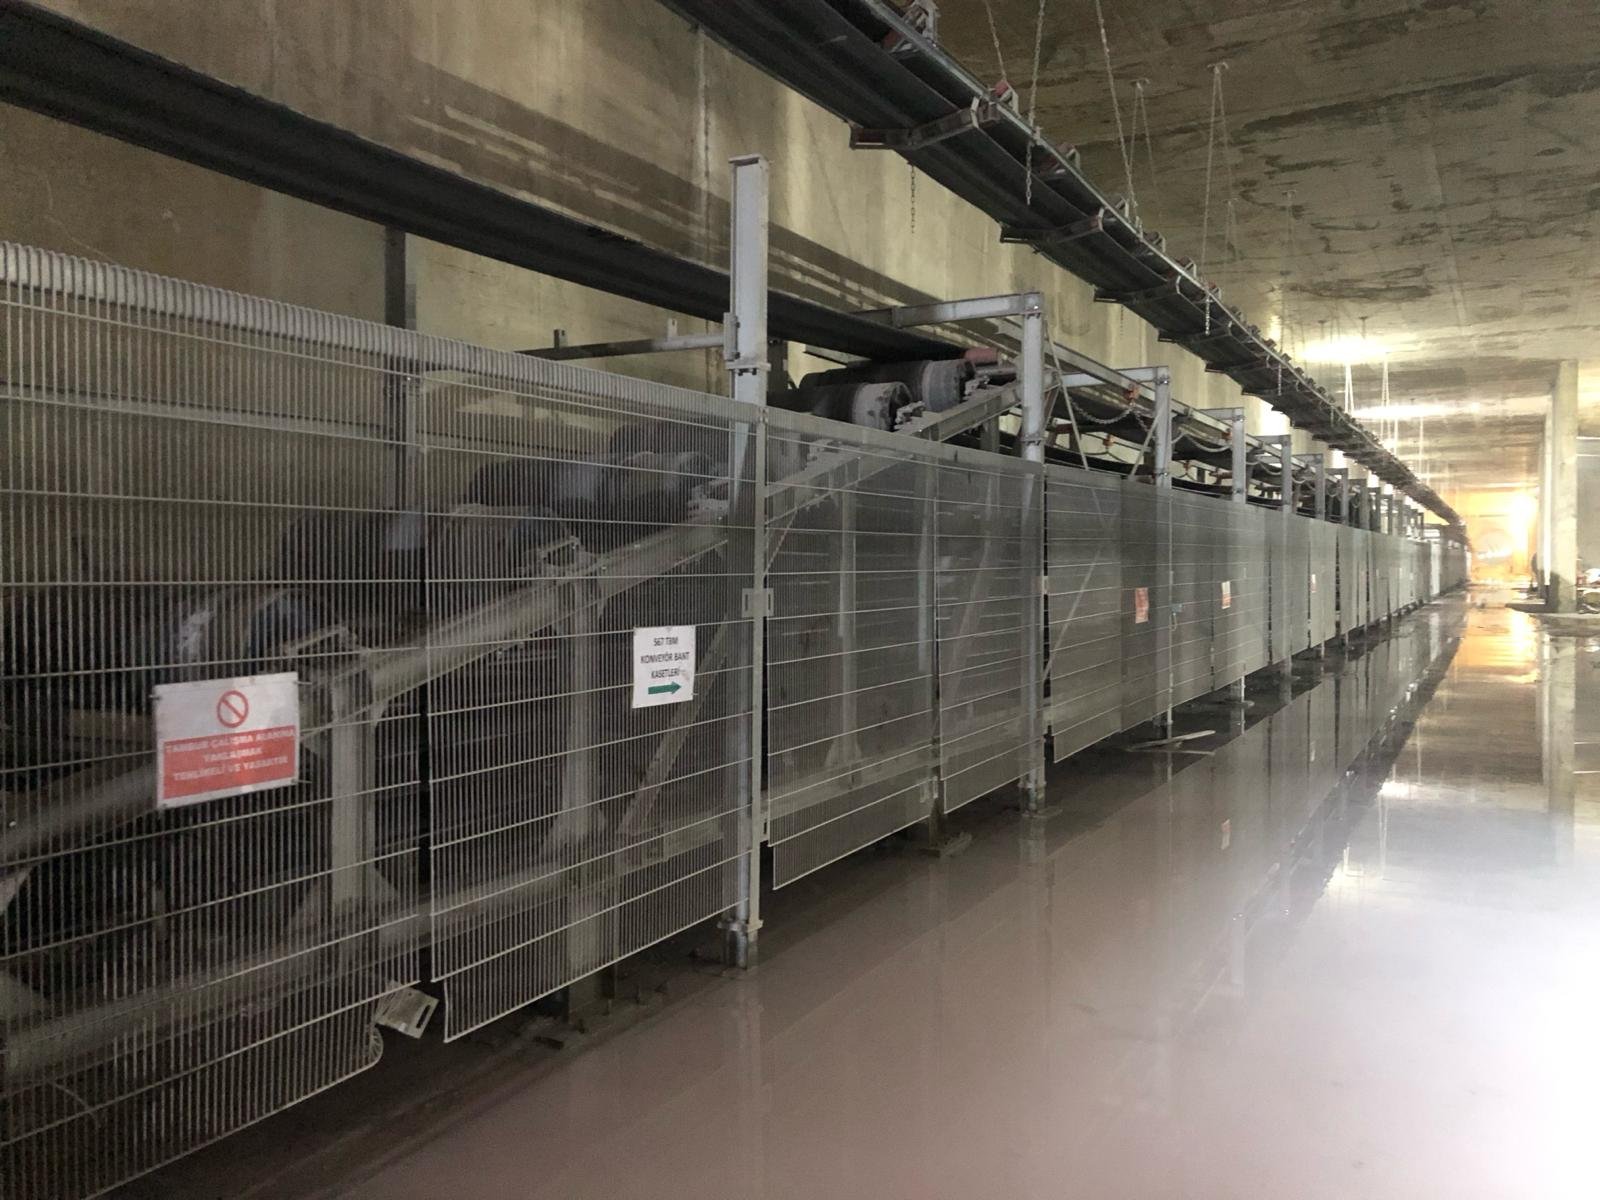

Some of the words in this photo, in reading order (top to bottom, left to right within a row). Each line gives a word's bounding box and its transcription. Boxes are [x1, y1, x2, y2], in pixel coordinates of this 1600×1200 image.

[674, 651, 690, 661] BANT
[211, 735, 253, 748] ÇALIŞMA
[228, 764, 241, 774] VE
